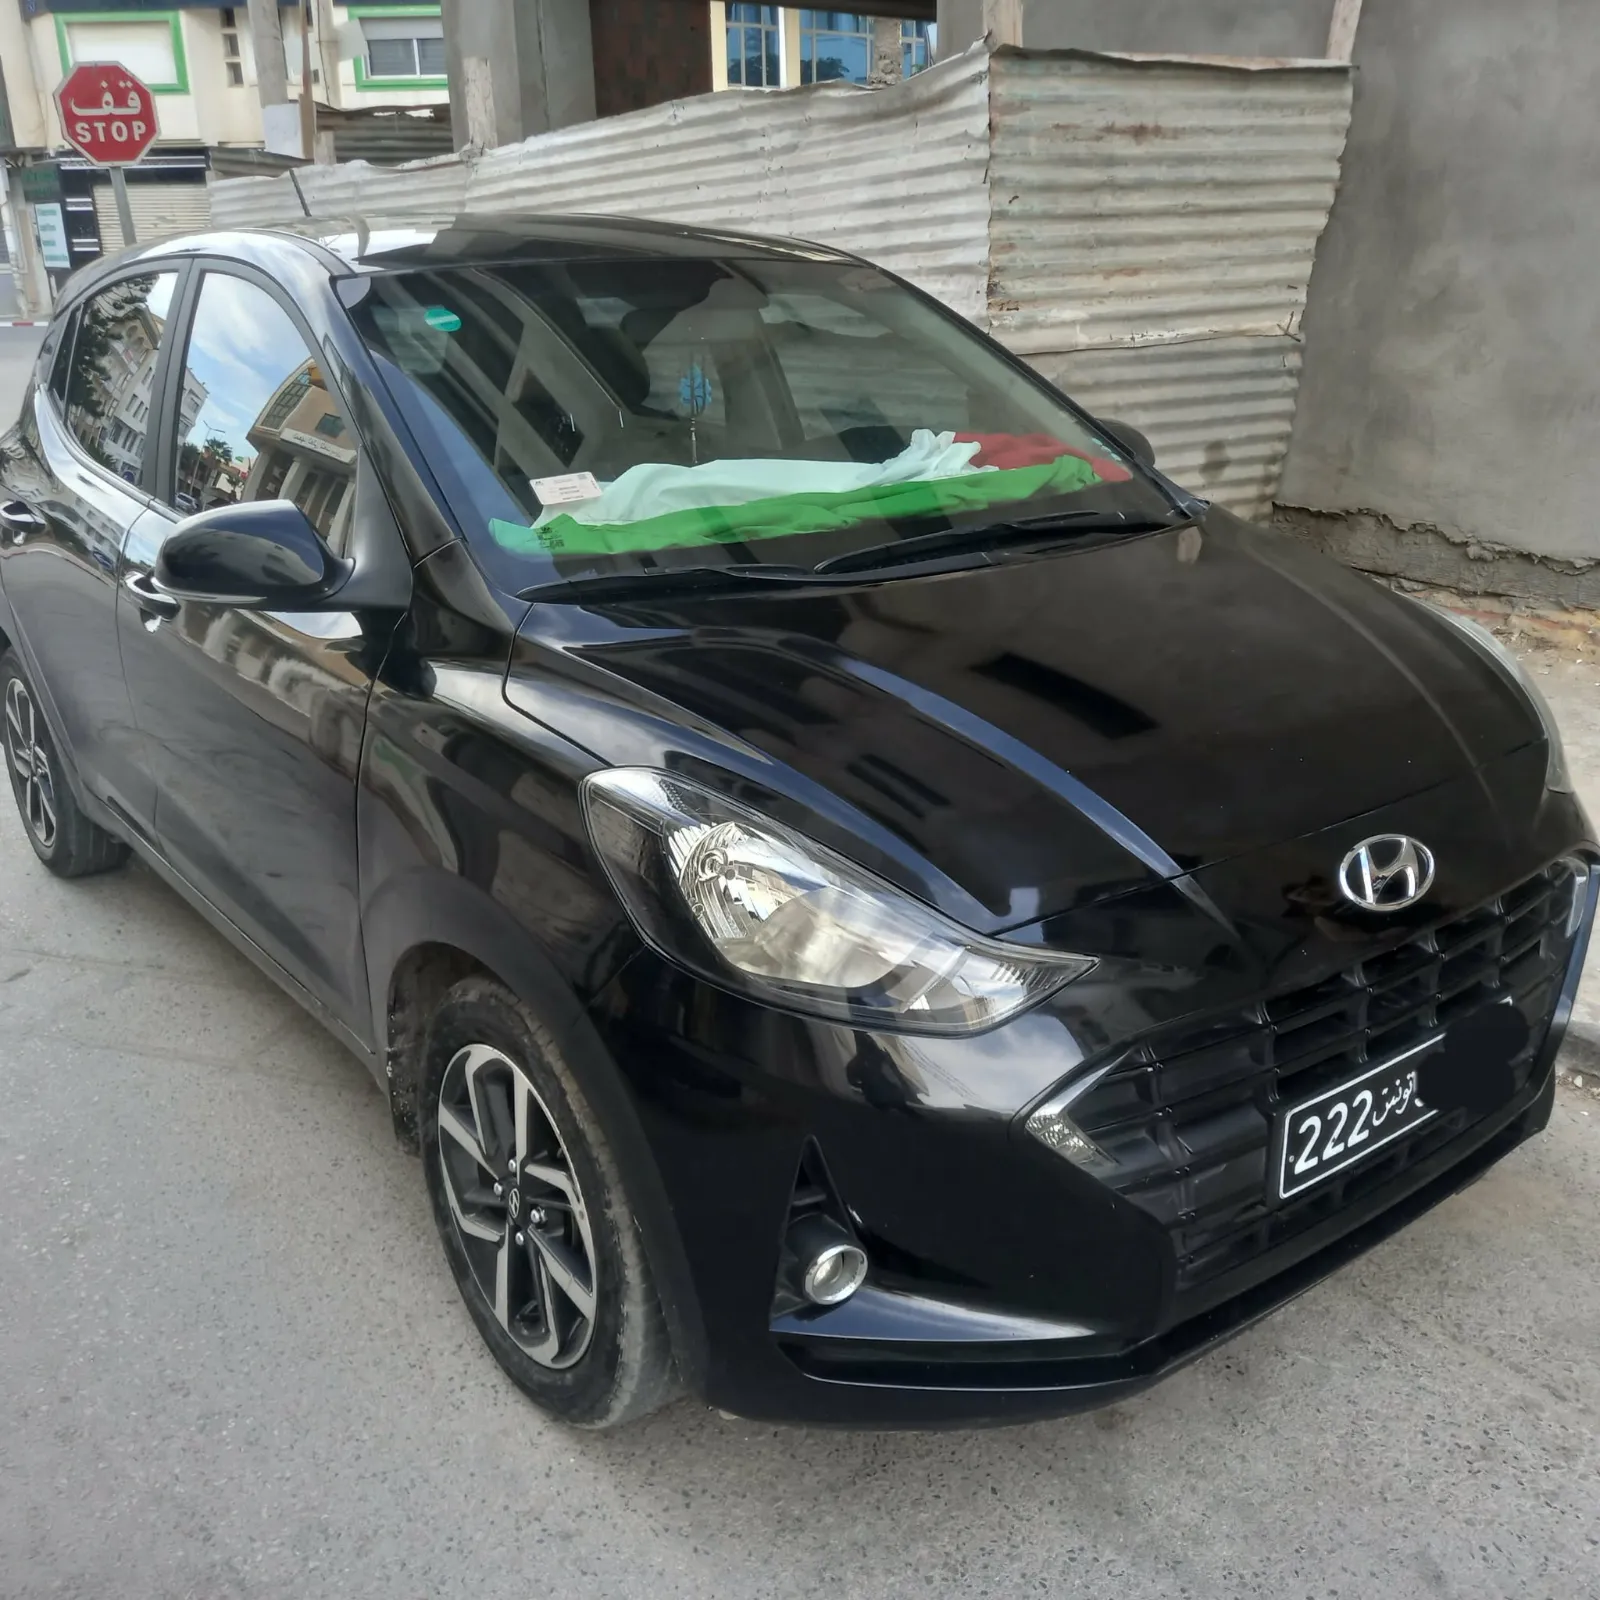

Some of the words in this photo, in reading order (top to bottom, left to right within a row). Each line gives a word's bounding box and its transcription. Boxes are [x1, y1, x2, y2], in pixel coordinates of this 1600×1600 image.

[70, 80, 142, 117] قف
[75, 120, 147, 144] STOP
[1294, 1089, 1373, 1175] 222
[1372, 1070, 1416, 1127] تونس
